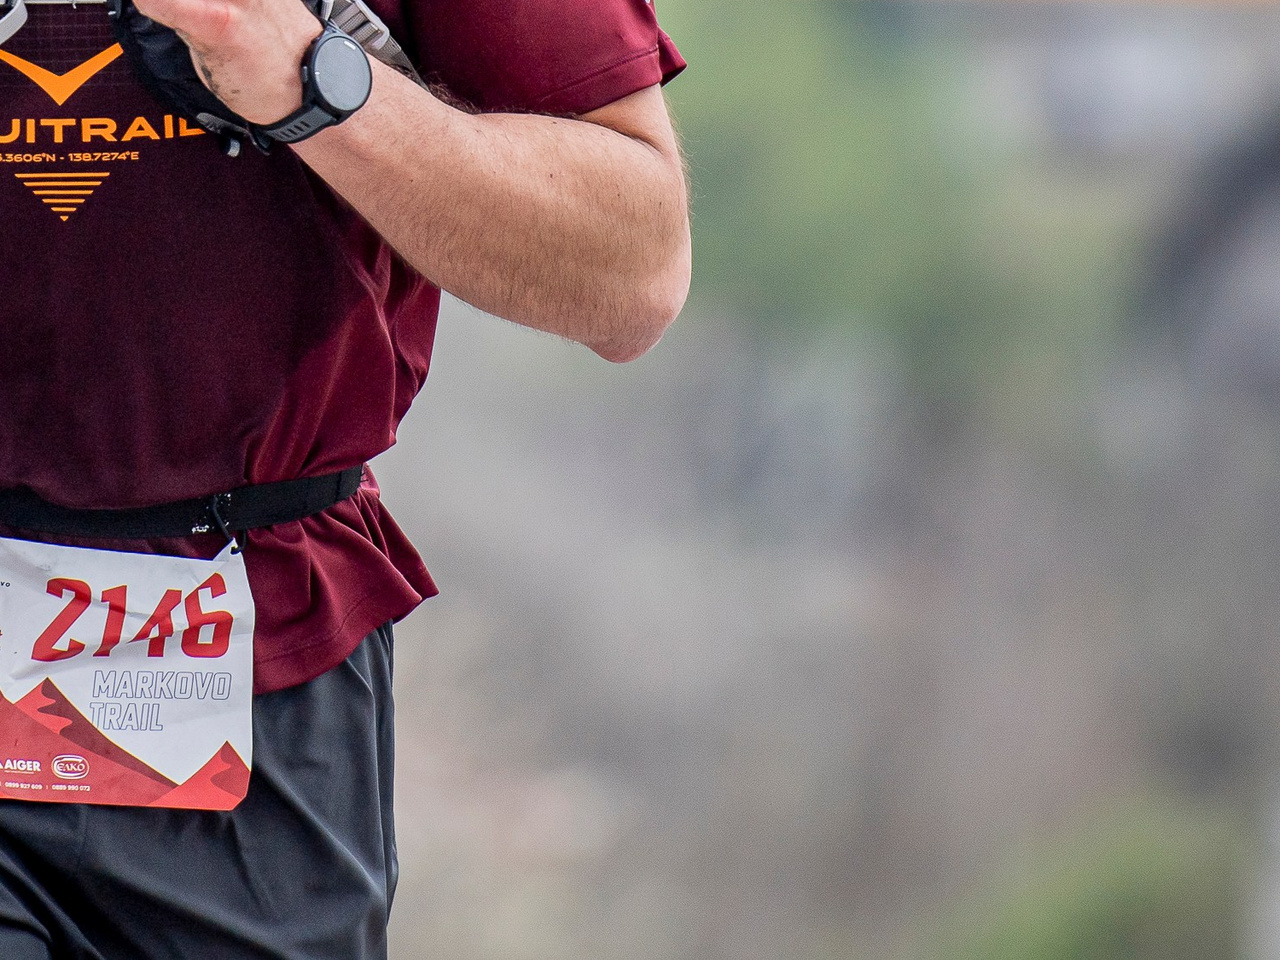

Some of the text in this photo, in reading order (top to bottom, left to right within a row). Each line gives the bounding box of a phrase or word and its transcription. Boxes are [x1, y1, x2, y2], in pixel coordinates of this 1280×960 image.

[68, 151, 140, 162] 138.7274°E
[31, 572, 234, 662] 2146
[92, 670, 233, 700] MARKOVO
[89, 701, 164, 731] TRAIL
[4, 758, 42, 772] AIGER
